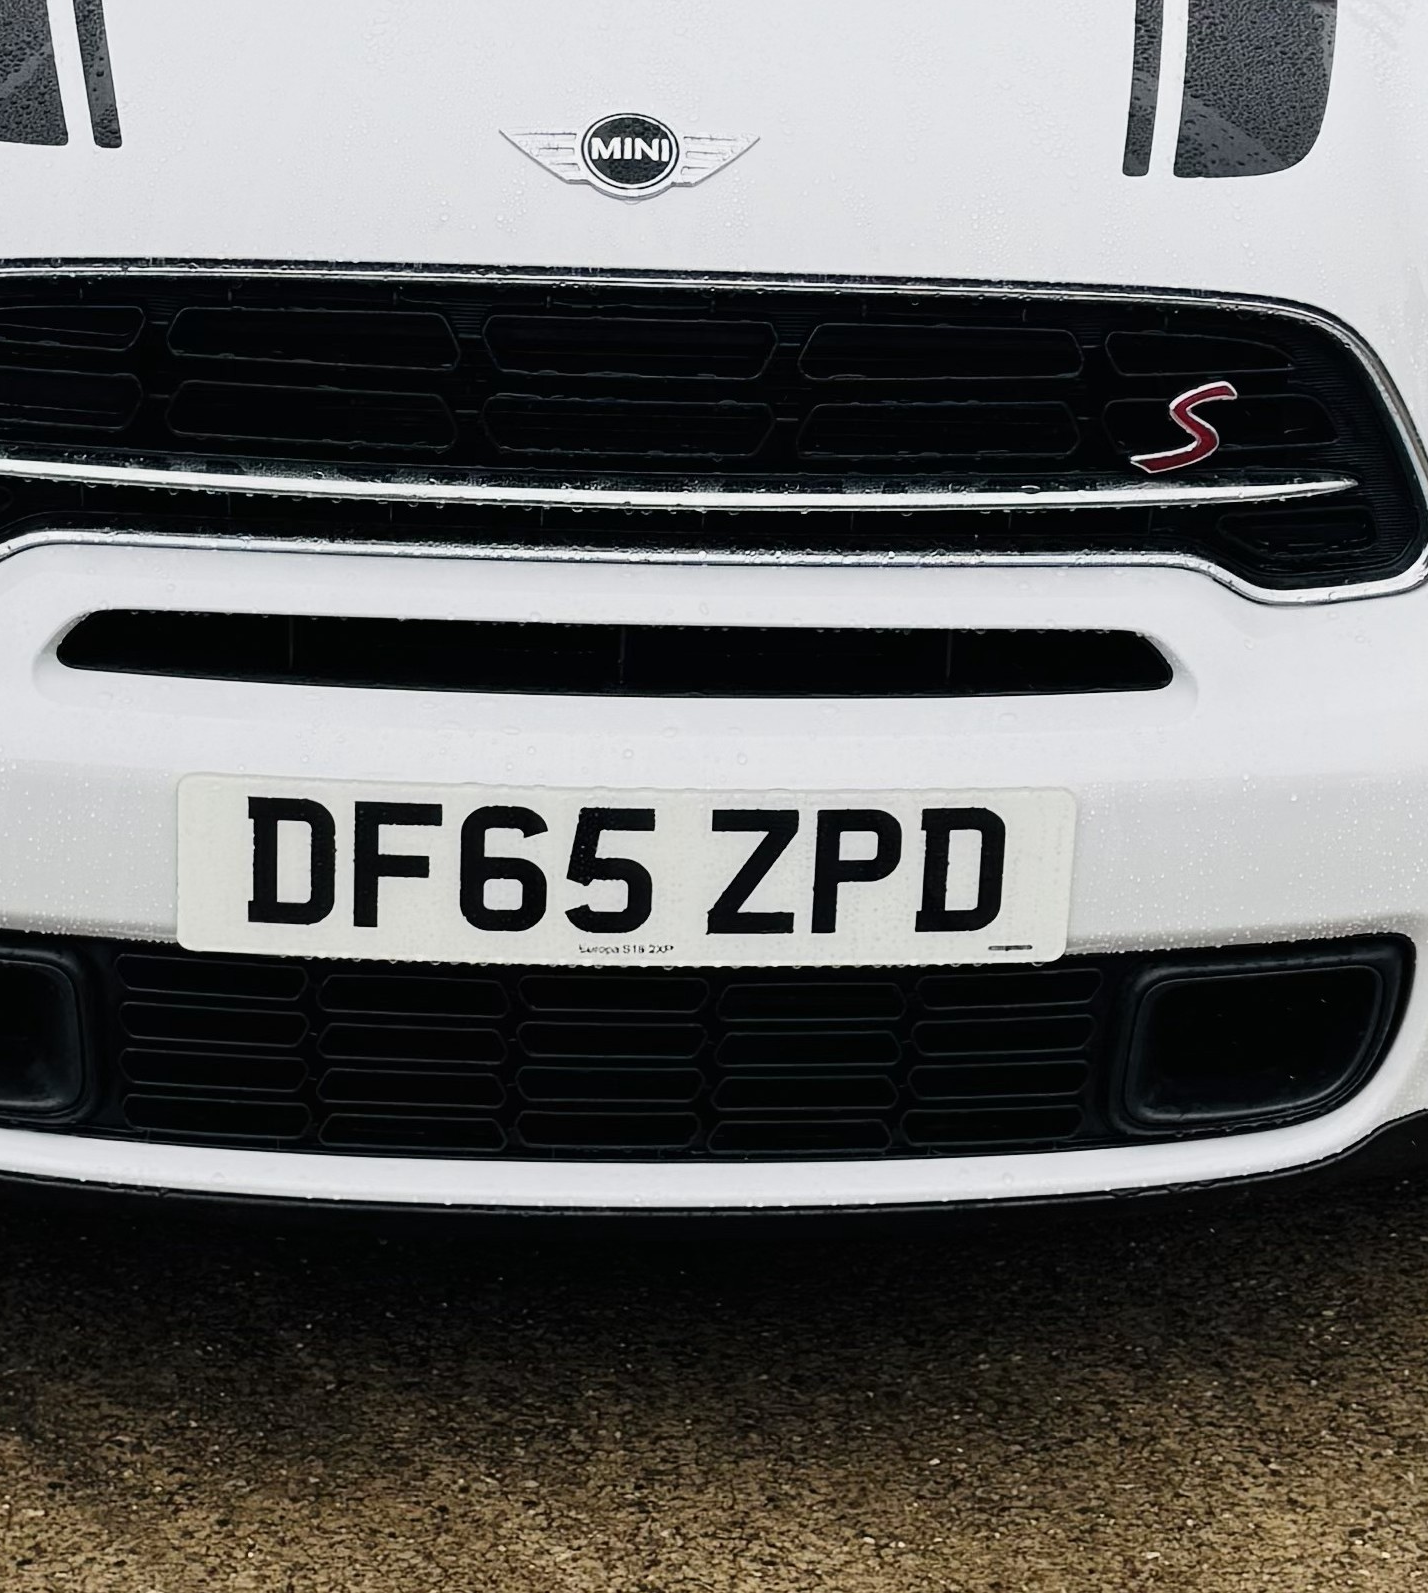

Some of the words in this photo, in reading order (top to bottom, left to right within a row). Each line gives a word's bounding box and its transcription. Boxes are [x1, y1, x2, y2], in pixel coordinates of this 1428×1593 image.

[589, 136, 671, 162] MINI
[1129, 380, 1238, 474] S
[246, 795, 657, 934] DF65
[706, 807, 1008, 934] ZPD
